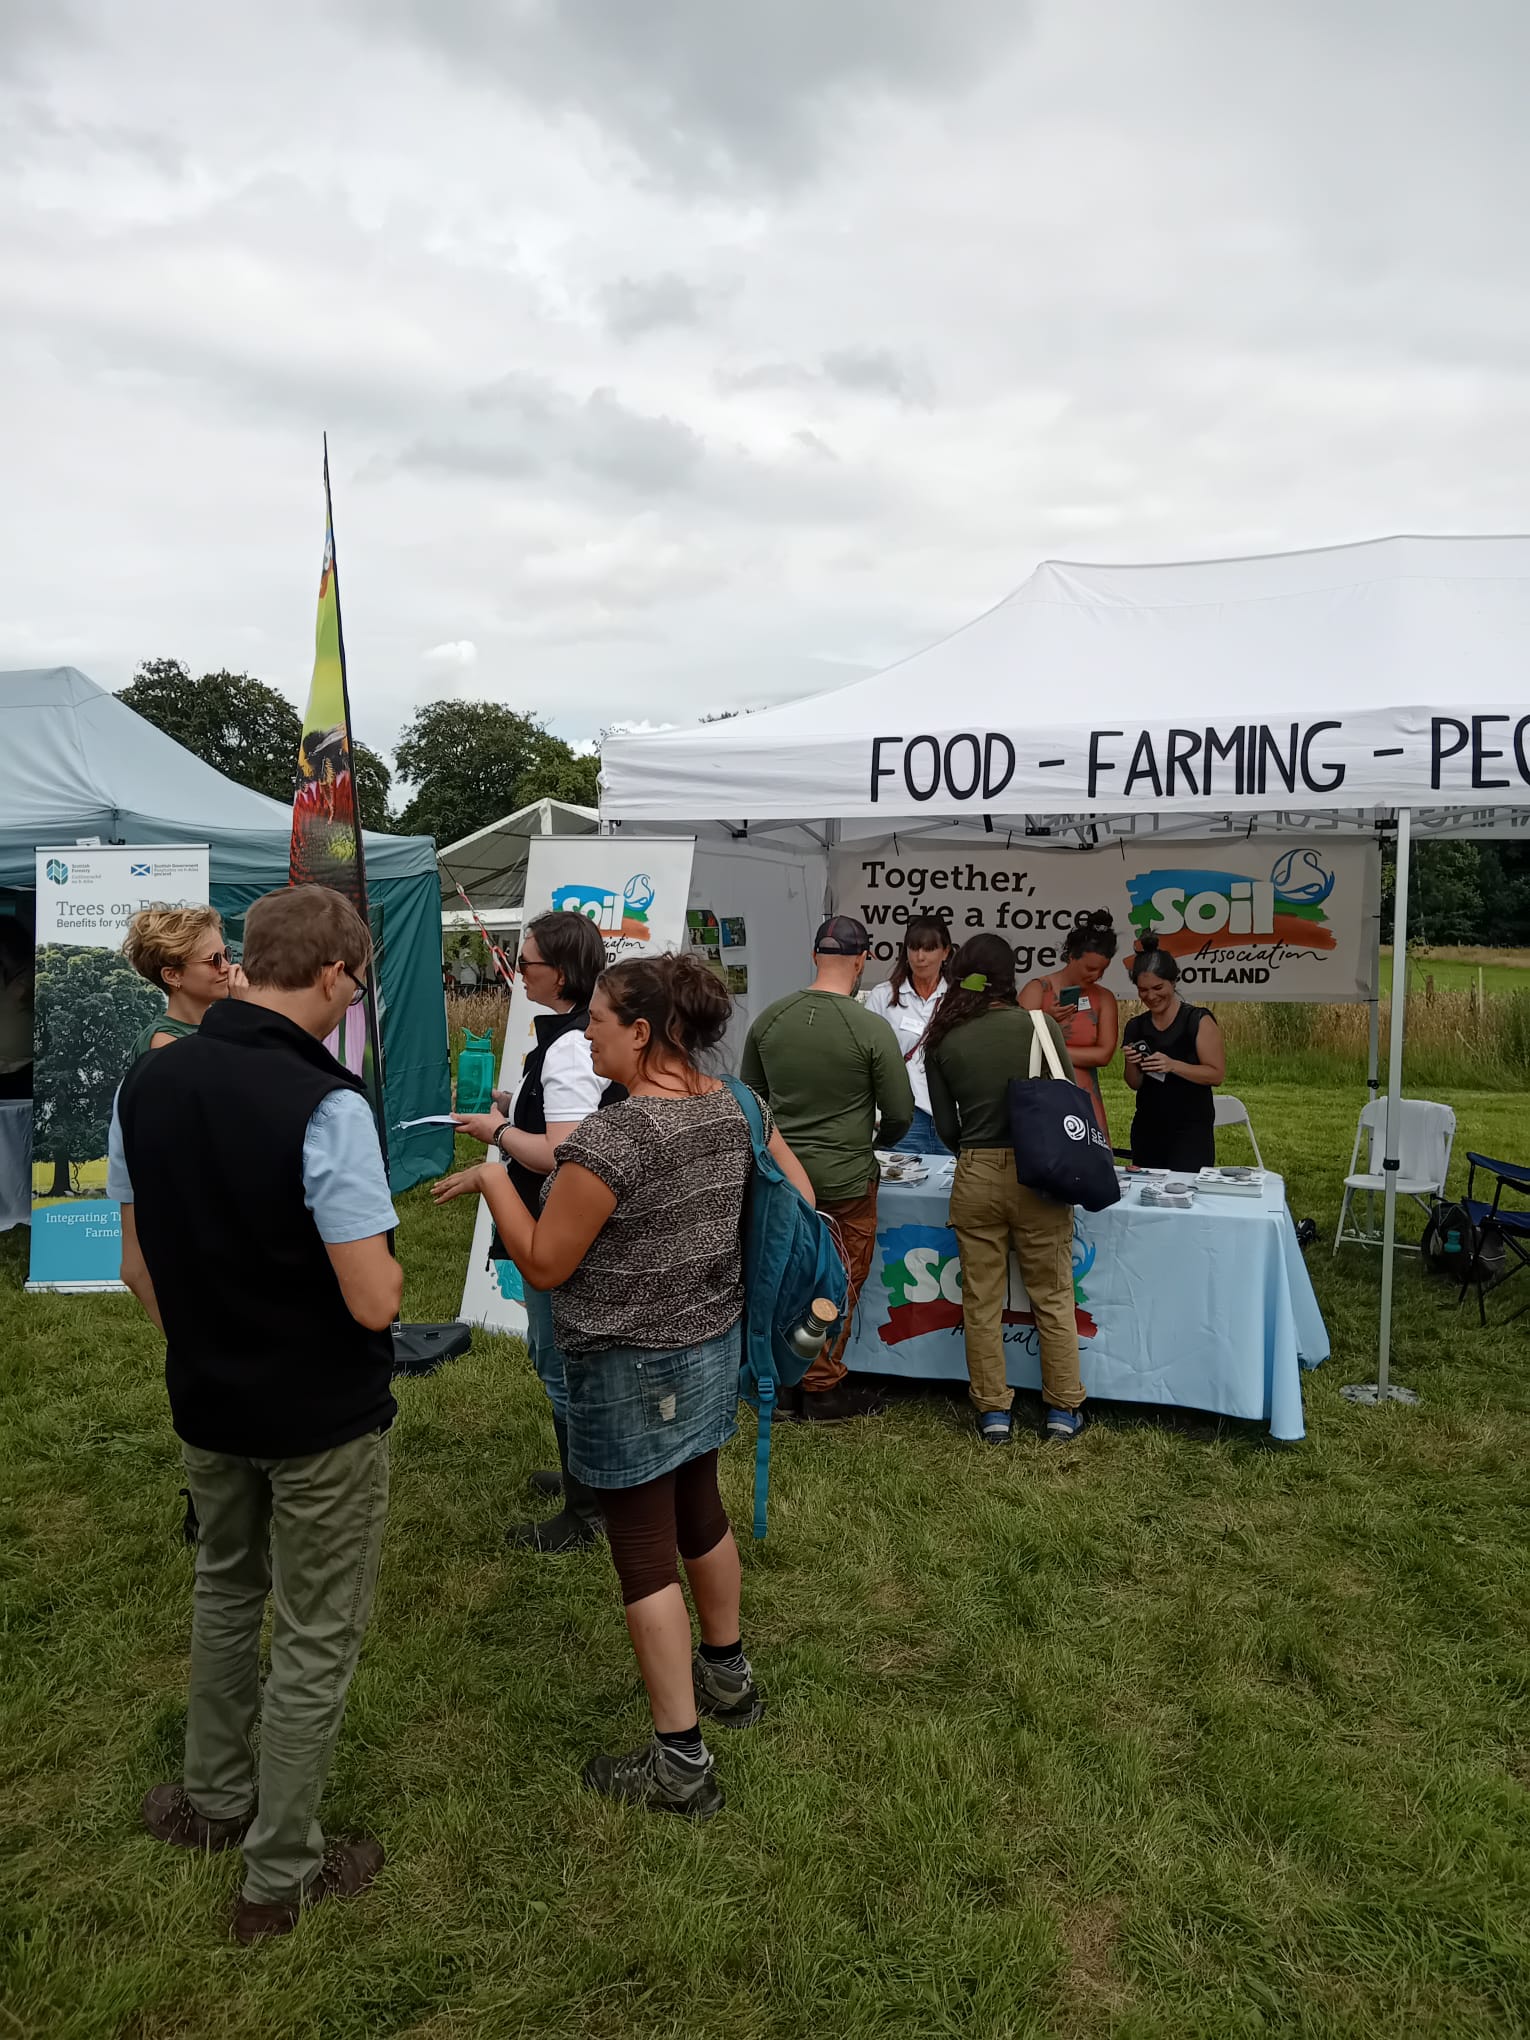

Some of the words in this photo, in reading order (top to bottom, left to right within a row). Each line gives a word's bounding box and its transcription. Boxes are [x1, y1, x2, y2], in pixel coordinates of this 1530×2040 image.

[871, 733, 1016, 803] FOOD
[1088, 721, 1346, 798] FARMING
[862, 861, 1036, 897] Together,
[56, 901, 105, 916] Trees
[110, 903, 132, 915] on
[964, 908, 985, 928] a
[996, 902, 1093, 931] force
[1151, 881, 1275, 935] soil
[56, 919, 97, 928] Benefits
[99, 918, 113, 928] for
[1194, 939, 1328, 969] Association
[1176, 967, 1271, 984] OTLAND
[46, 1213, 108, 1225] Integrating
